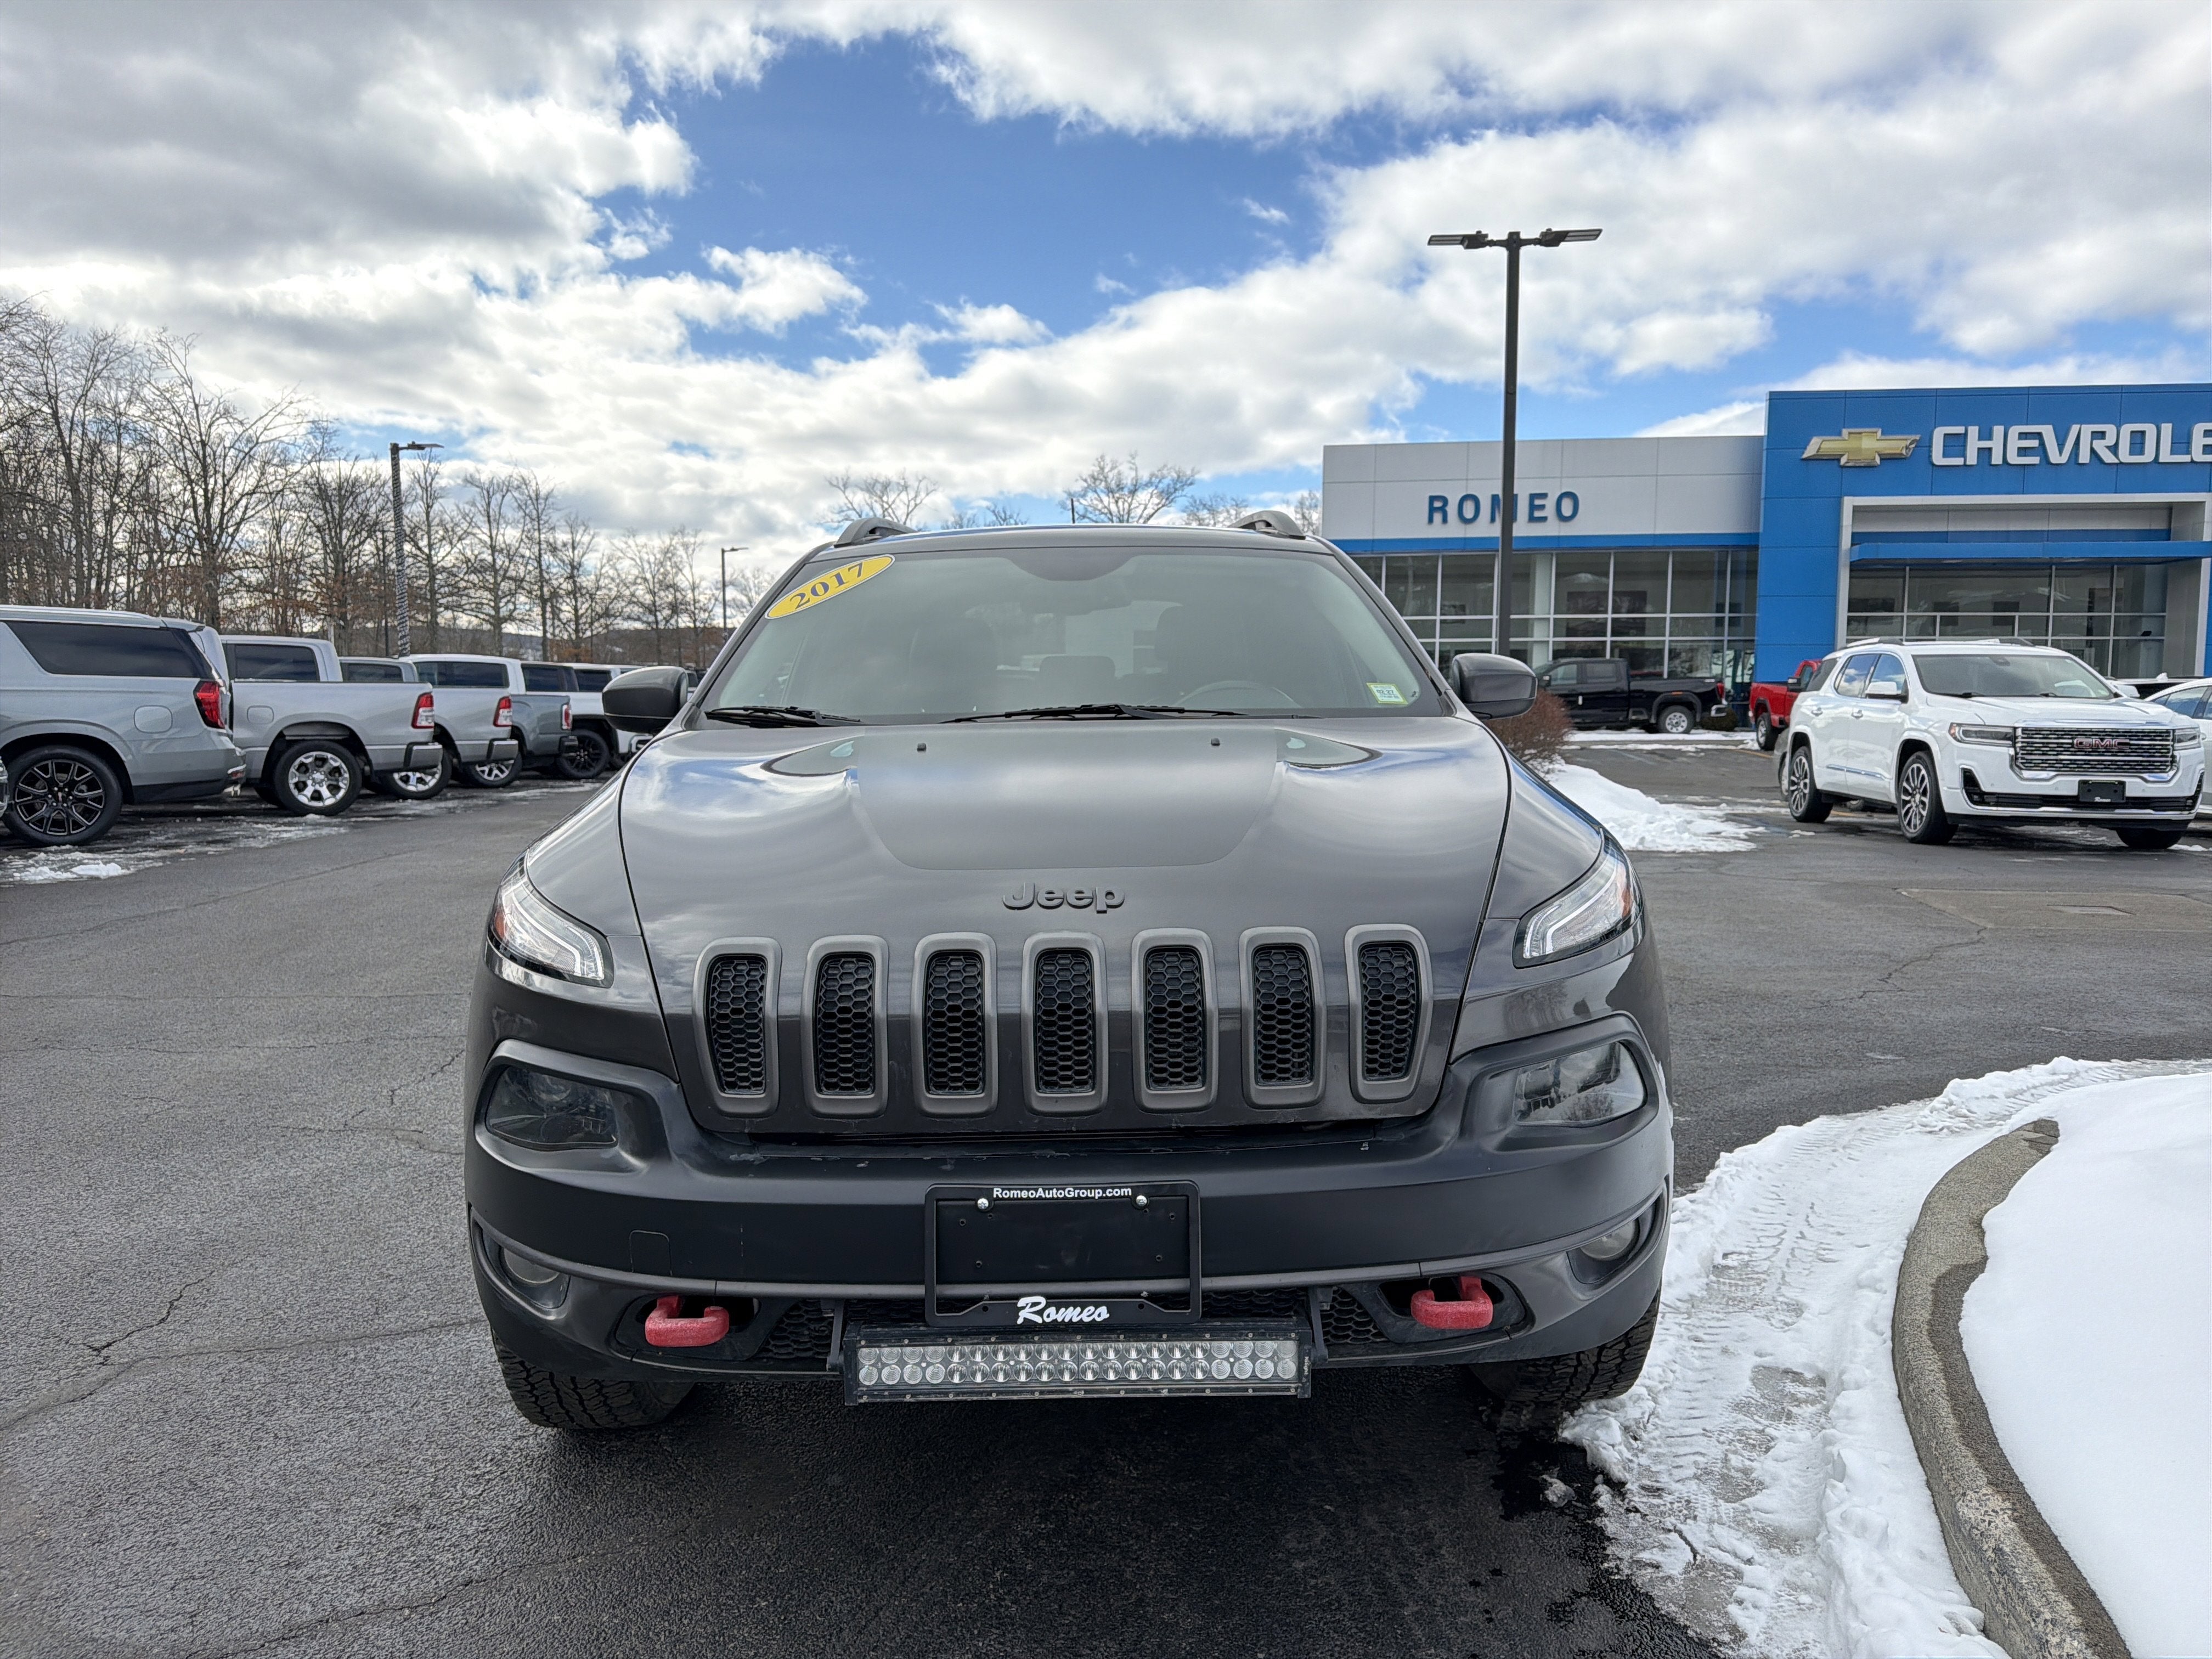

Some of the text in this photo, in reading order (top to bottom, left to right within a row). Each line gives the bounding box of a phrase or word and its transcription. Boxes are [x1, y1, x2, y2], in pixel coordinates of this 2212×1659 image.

[789, 562, 863, 610] 2017
[2074, 738, 2130, 749] GMC
[1002, 882, 1125, 914] Jeep
[993, 1187, 1132, 1199] RomeoAutoGroup.com
[1017, 1296, 1110, 1324] Romeo
